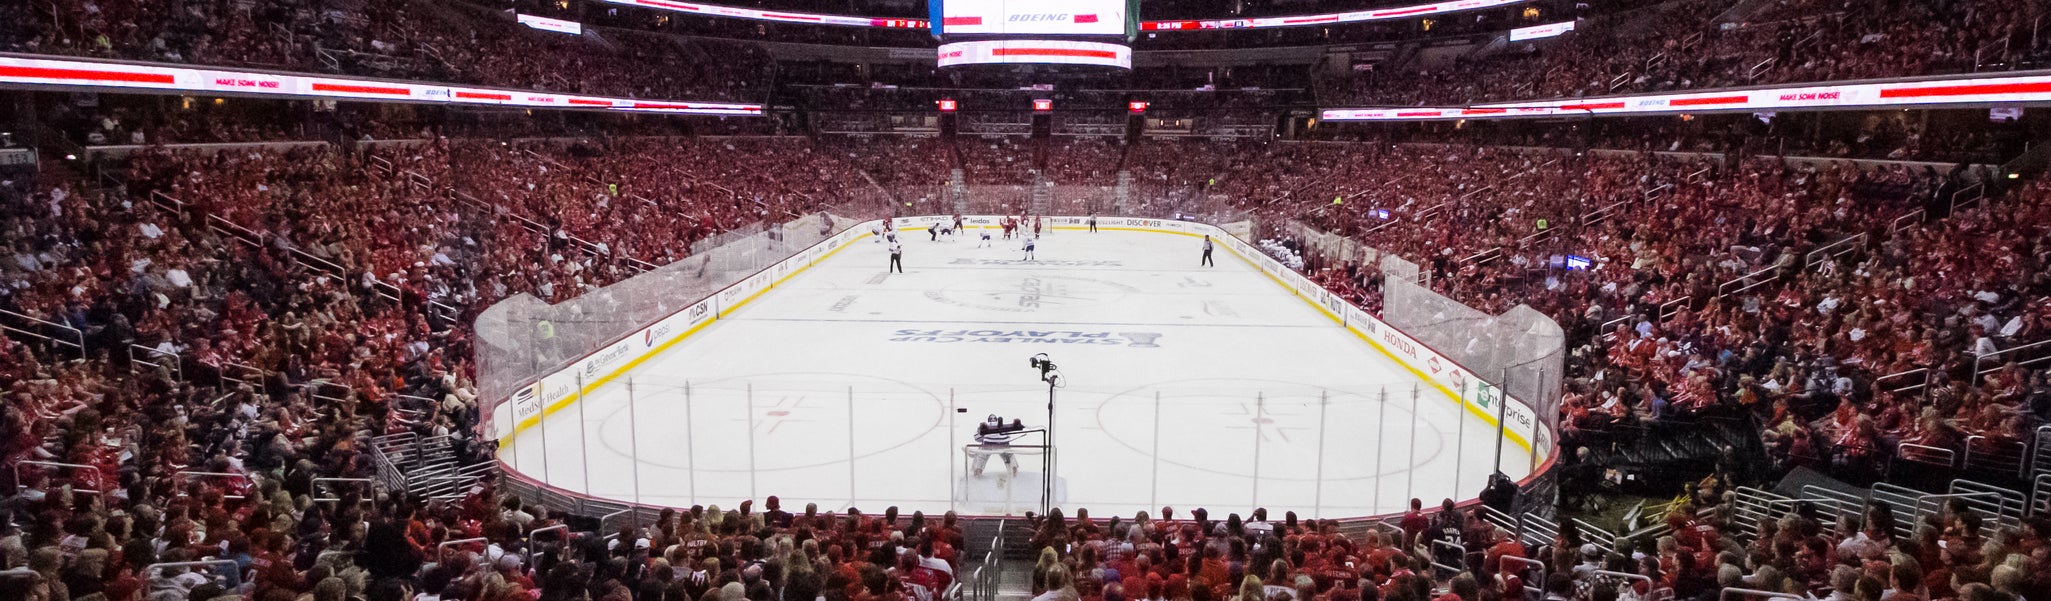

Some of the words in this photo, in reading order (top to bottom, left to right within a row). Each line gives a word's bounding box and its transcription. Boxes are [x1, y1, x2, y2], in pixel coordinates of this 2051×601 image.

[1008, 13, 1069, 22] BOEING
[216, 78, 235, 86] MAKE
[1798, 93, 1816, 101] SOME
[1818, 91, 1841, 100] NOISE!
[1126, 218, 1161, 228] DISCOVER
[695, 301, 708, 317] CSN
[654, 321, 671, 343] pepsi
[894, 329, 1110, 338] PLAYOFFS
[888, 336, 964, 344] CUP
[968, 337, 1125, 346] STANLEY
[1384, 330, 1417, 360] HONDA
[547, 383, 569, 403] Health
[1479, 391, 1531, 430] entprise
